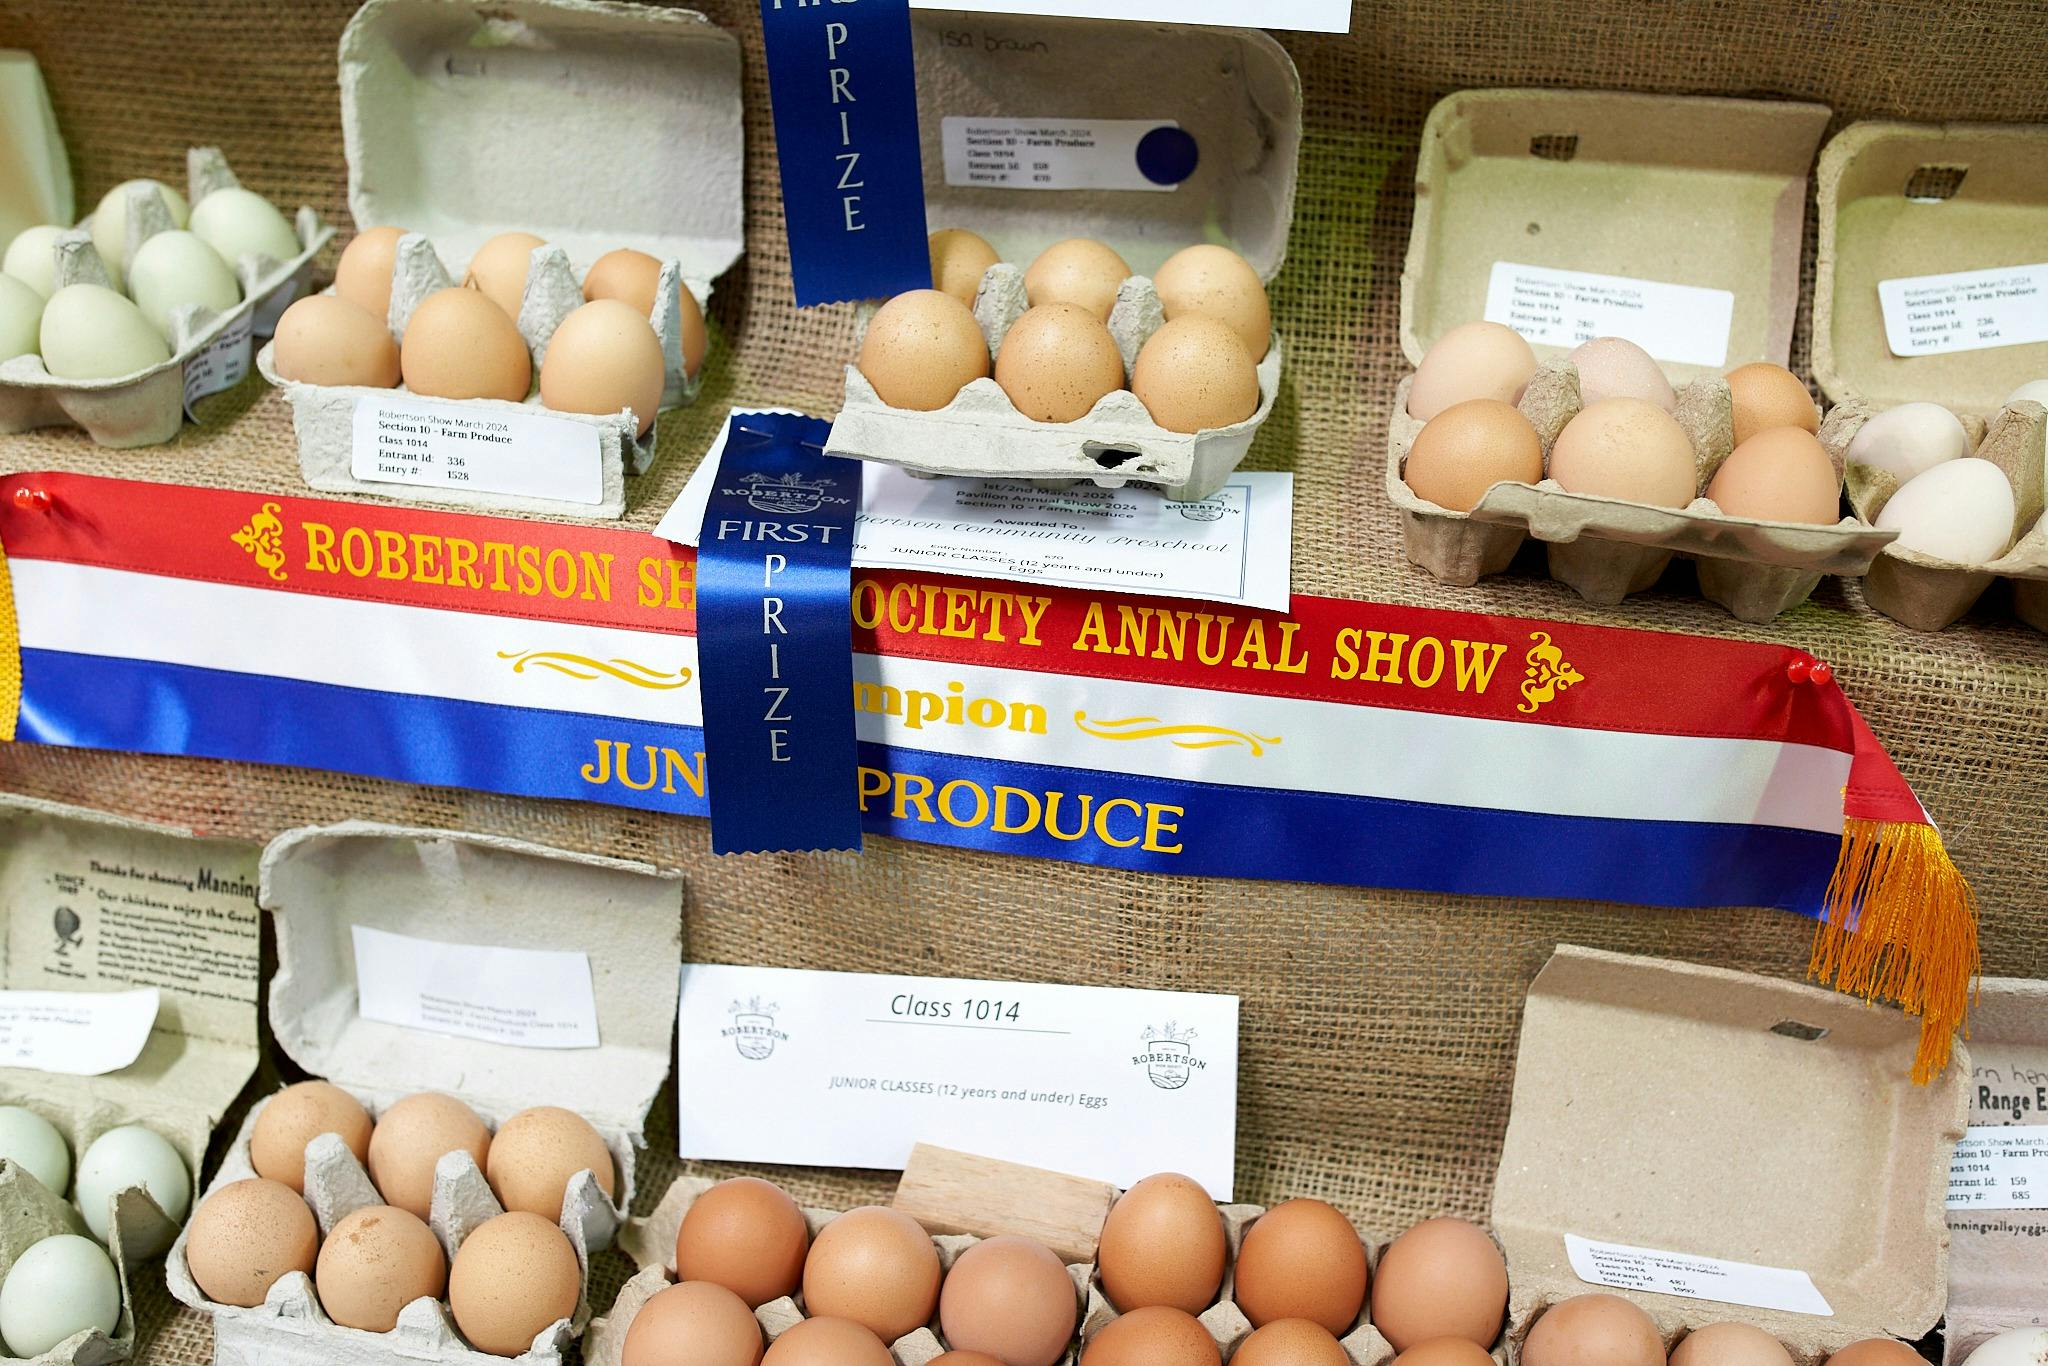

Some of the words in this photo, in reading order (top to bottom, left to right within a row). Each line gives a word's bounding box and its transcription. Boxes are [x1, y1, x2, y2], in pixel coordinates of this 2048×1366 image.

[826, 22, 866, 232] PRIZE
[1055, 139, 1095, 147] Produce
[1967, 292, 1993, 301] Farm
[1996, 287, 2038, 298] Produce
[379, 410, 426, 423] Robertson
[428, 415, 453, 426] Show
[455, 419, 484, 430] March
[486, 423, 509, 432] 2024
[378, 421, 417, 433] Section
[419, 425, 431, 434] 10
[441, 428, 468, 439] Farm
[470, 431, 513, 445] Produce
[378, 435, 403, 446] Class
[406, 439, 428, 448] 1014
[379, 449, 419, 462] Entrant
[447, 456, 465, 466] 336
[378, 463, 407, 477] Entry
[447, 470, 469, 481] 1528
[721, 488, 851, 505] ROBERTSON
[983, 482, 1033, 494] 1st/2nd
[1037, 487, 1079, 498] March
[1082, 491, 1115, 499] 2024
[956, 490, 1008, 500] Pavilion
[1011, 494, 1060, 504] Annual
[1063, 498, 1102, 507] Show
[1105, 502, 1138, 511] 2024
[1165, 504, 1240, 514] ROBERTSON
[956, 500, 1006, 509] Section
[1038, 505, 1074, 514] Farm
[1076, 508, 1134, 519] Produce
[717, 520, 843, 543] FIRST
[993, 518, 1057, 529] Awarded
[855, 514, 945, 530] bertson
[952, 523, 1097, 544] Community
[1106, 535, 1231, 553] Preschool
[890, 547, 948, 558] JUNIOR
[951, 553, 1016, 565] CLASSES
[1020, 558, 1038, 567] (12
[1042, 562, 1080, 572] years
[1085, 564, 1112, 574] and
[1116, 568, 1164, 579] under)
[1009, 566, 1044, 575] Eggs
[302, 521, 614, 602] ROBERTSON
[638, 556, 698, 610] SH
[852, 579, 1052, 646] OCIETY
[1072, 602, 1309, 674] ANNUAL
[1330, 627, 1508, 694] SHOW
[762, 554, 793, 763] PRIZE
[853, 681, 1047, 735] mpion
[581, 739, 706, 797] JUN
[857, 766, 1185, 854] PRODUCE
[129, 867, 145, 880] for
[174, 903, 202, 918] enjoy
[206, 904, 223, 919] the
[891, 994, 952, 1018] Class
[963, 999, 1021, 1022] 1014
[721, 1026, 789, 1041] ROBERTSON
[1132, 1053, 1207, 1070] ROBERTSON
[829, 1075, 877, 1090] JUNIOR
[881, 1079, 934, 1094] CLASSES
[937, 1083, 957, 1097] (12
[960, 1087, 997, 1100] years
[1001, 1088, 1026, 1102] and
[1030, 1091, 1075, 1106] under)
[1078, 1093, 1109, 1109] Eggs
[1978, 1085, 2030, 1120] Range
[1956, 1138, 1986, 1147] ertson
[1987, 1138, 2012, 1147] Show
[2015, 1138, 2044, 1146] March
[1980, 1149, 1992, 1158] 10
[2002, 1149, 2029, 1157] Farm
[1967, 1164, 1990, 1172] 1014
[1949, 1178, 1981, 1187] ntrant
[2010, 1176, 2027, 1186] 159
[1946, 1193, 1971, 1204] ntry
[2011, 1190, 2030, 1200] 685
[1595, 1262, 1621, 1270] Class
[1599, 1269, 1639, 1279] Entrant
[1685, 1266, 1728, 1276] Produce
[1603, 1277, 1632, 1286] Entry
